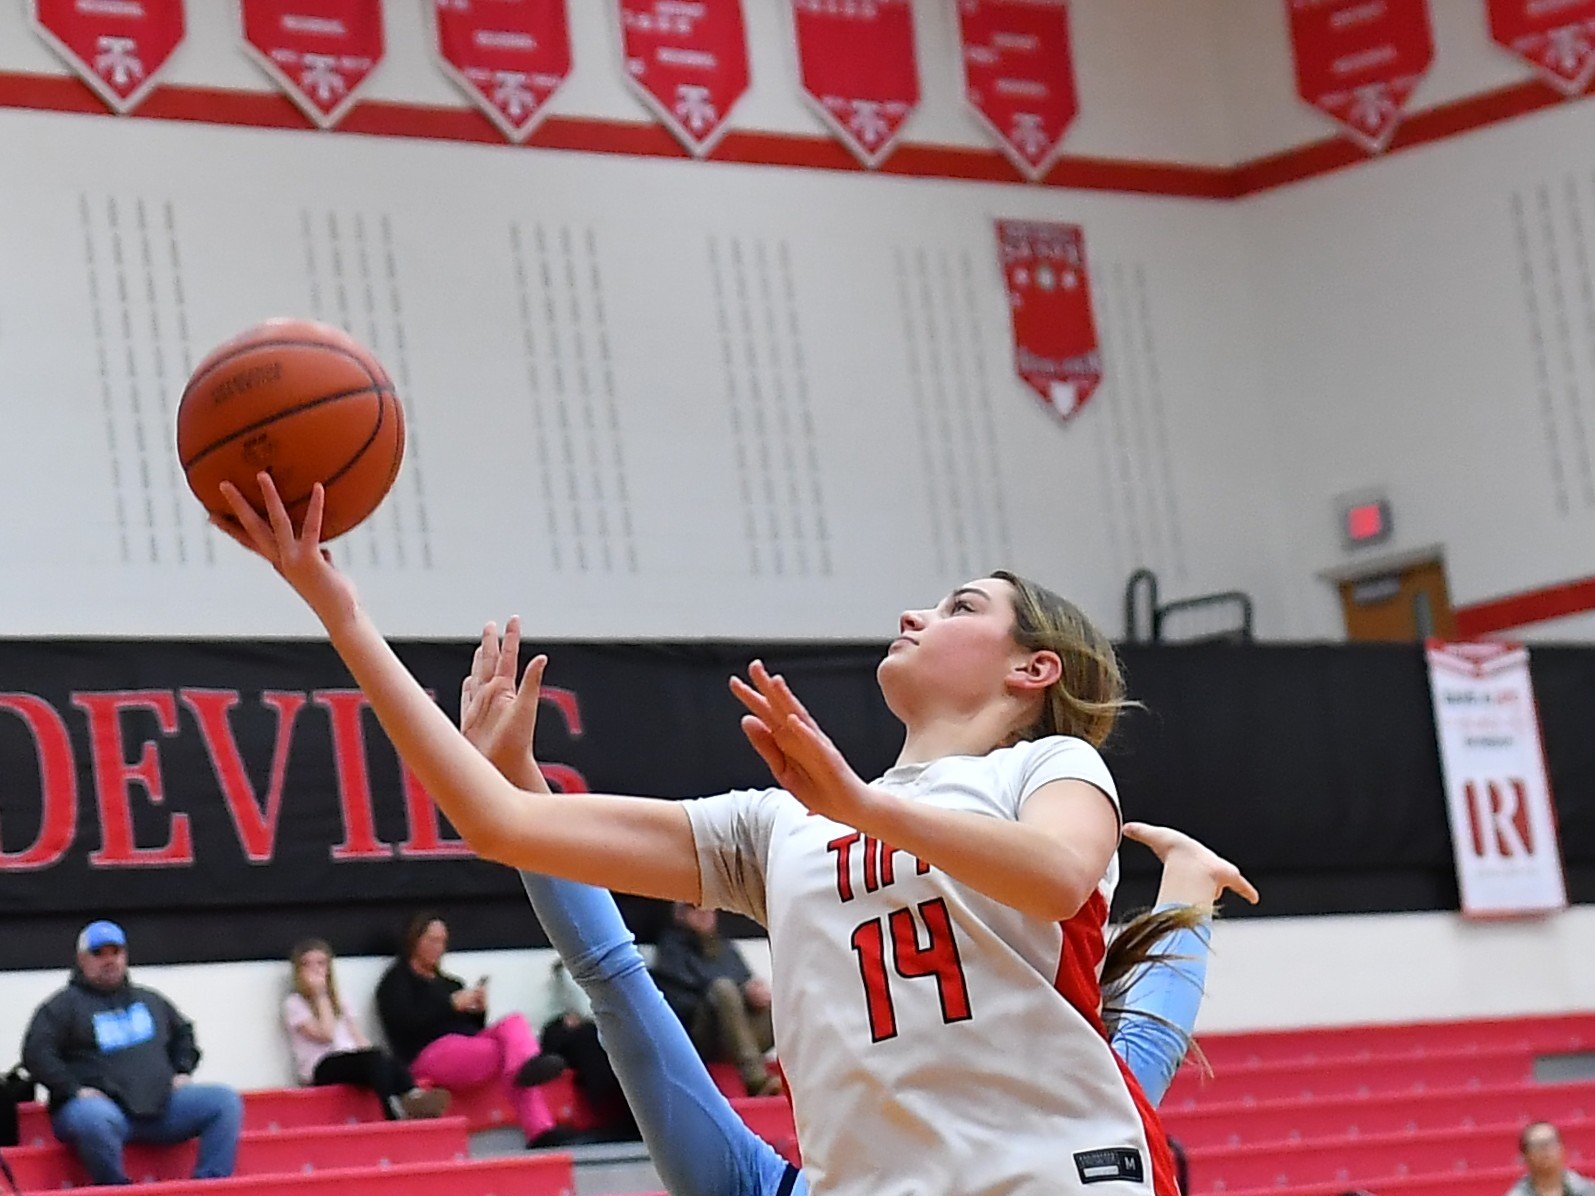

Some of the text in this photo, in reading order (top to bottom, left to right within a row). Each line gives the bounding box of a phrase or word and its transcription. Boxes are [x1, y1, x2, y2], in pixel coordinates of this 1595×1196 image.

[0, 687, 588, 870] DEVI
[826, 831, 931, 903] TI
[850, 896, 973, 1043] 14
